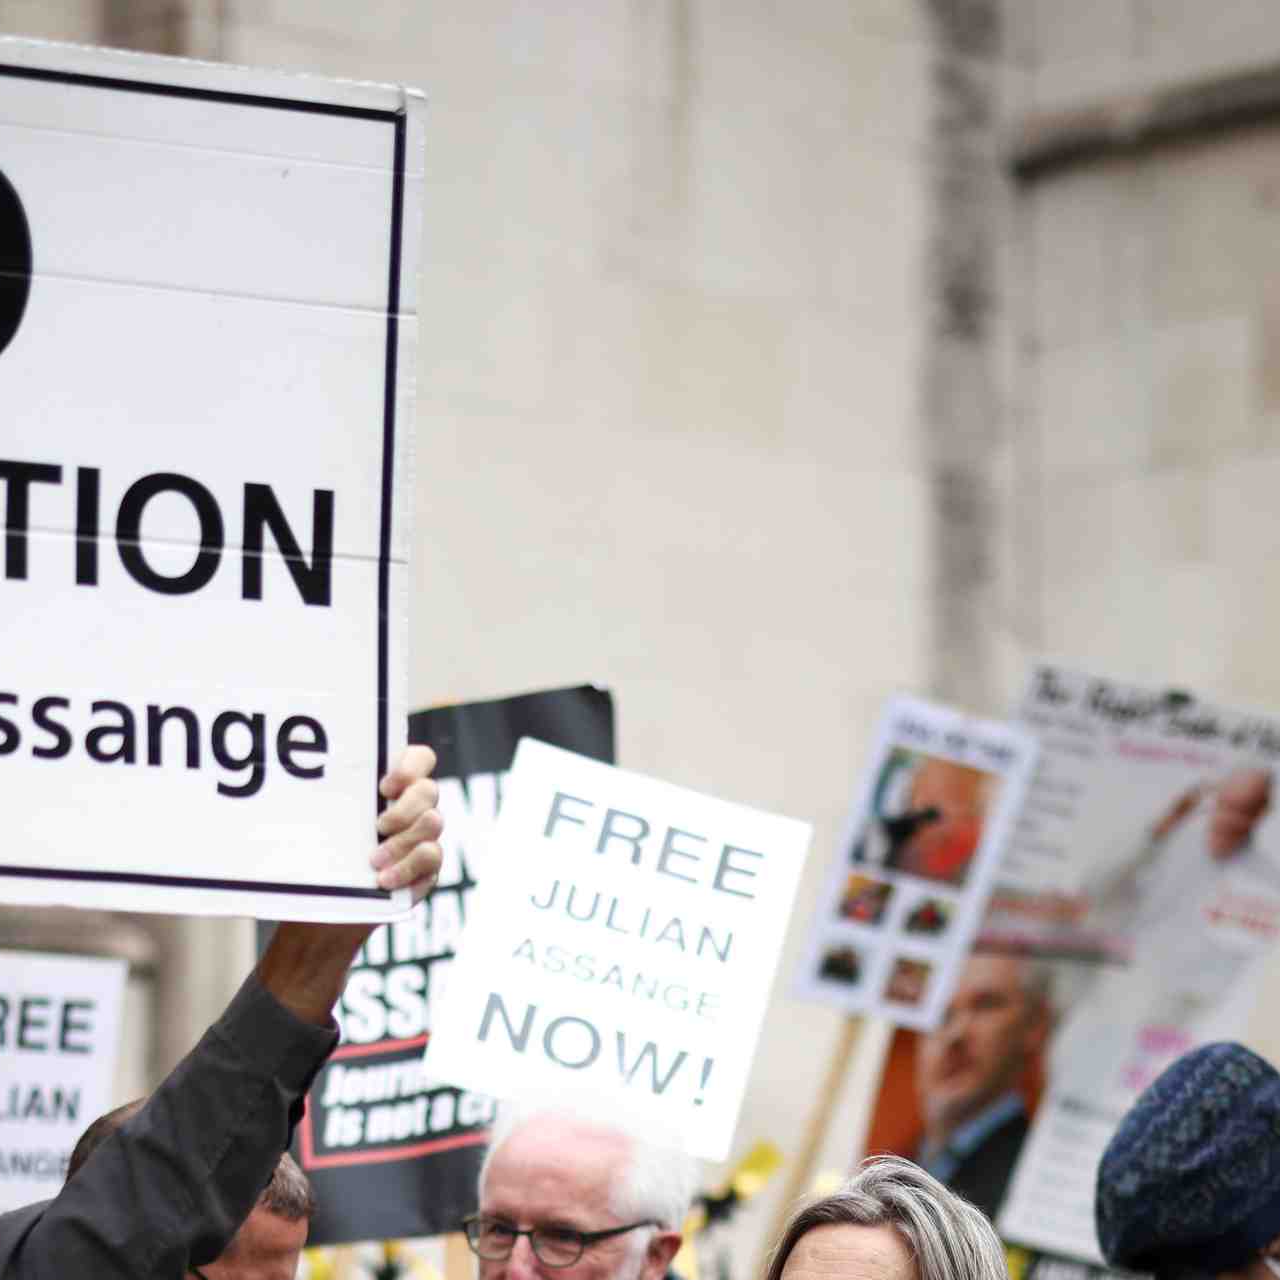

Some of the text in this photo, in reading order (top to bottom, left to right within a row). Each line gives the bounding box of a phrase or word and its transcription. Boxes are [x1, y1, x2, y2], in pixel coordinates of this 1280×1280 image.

[542, 790, 765, 900] FREE
[531, 879, 734, 963] JULIAN
[511, 937, 721, 1020] ASSANGE
[476, 991, 715, 1106] NOW!
